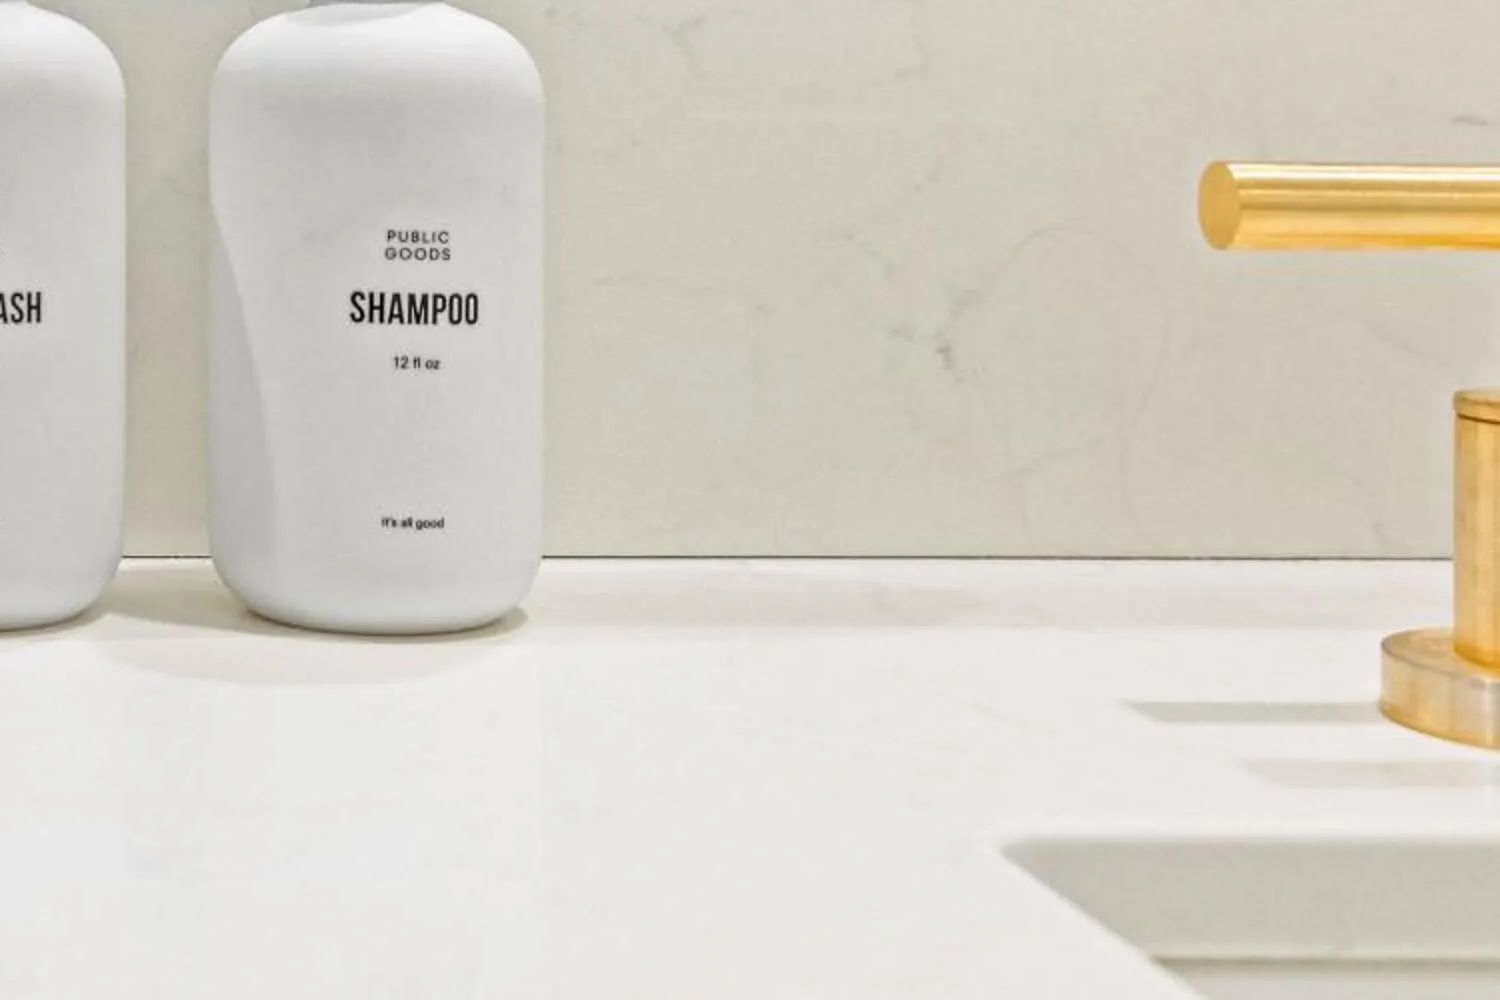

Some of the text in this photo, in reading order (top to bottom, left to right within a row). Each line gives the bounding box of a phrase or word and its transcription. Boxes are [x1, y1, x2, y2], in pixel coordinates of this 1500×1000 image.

[386, 229, 449, 244] PUBLIC
[384, 247, 451, 261] GOODS
[349, 291, 479, 326] SHAMPOO
[393, 355, 441, 370] 12 fl oz
[400, 516, 413, 528] all
[415, 516, 445, 531] good
